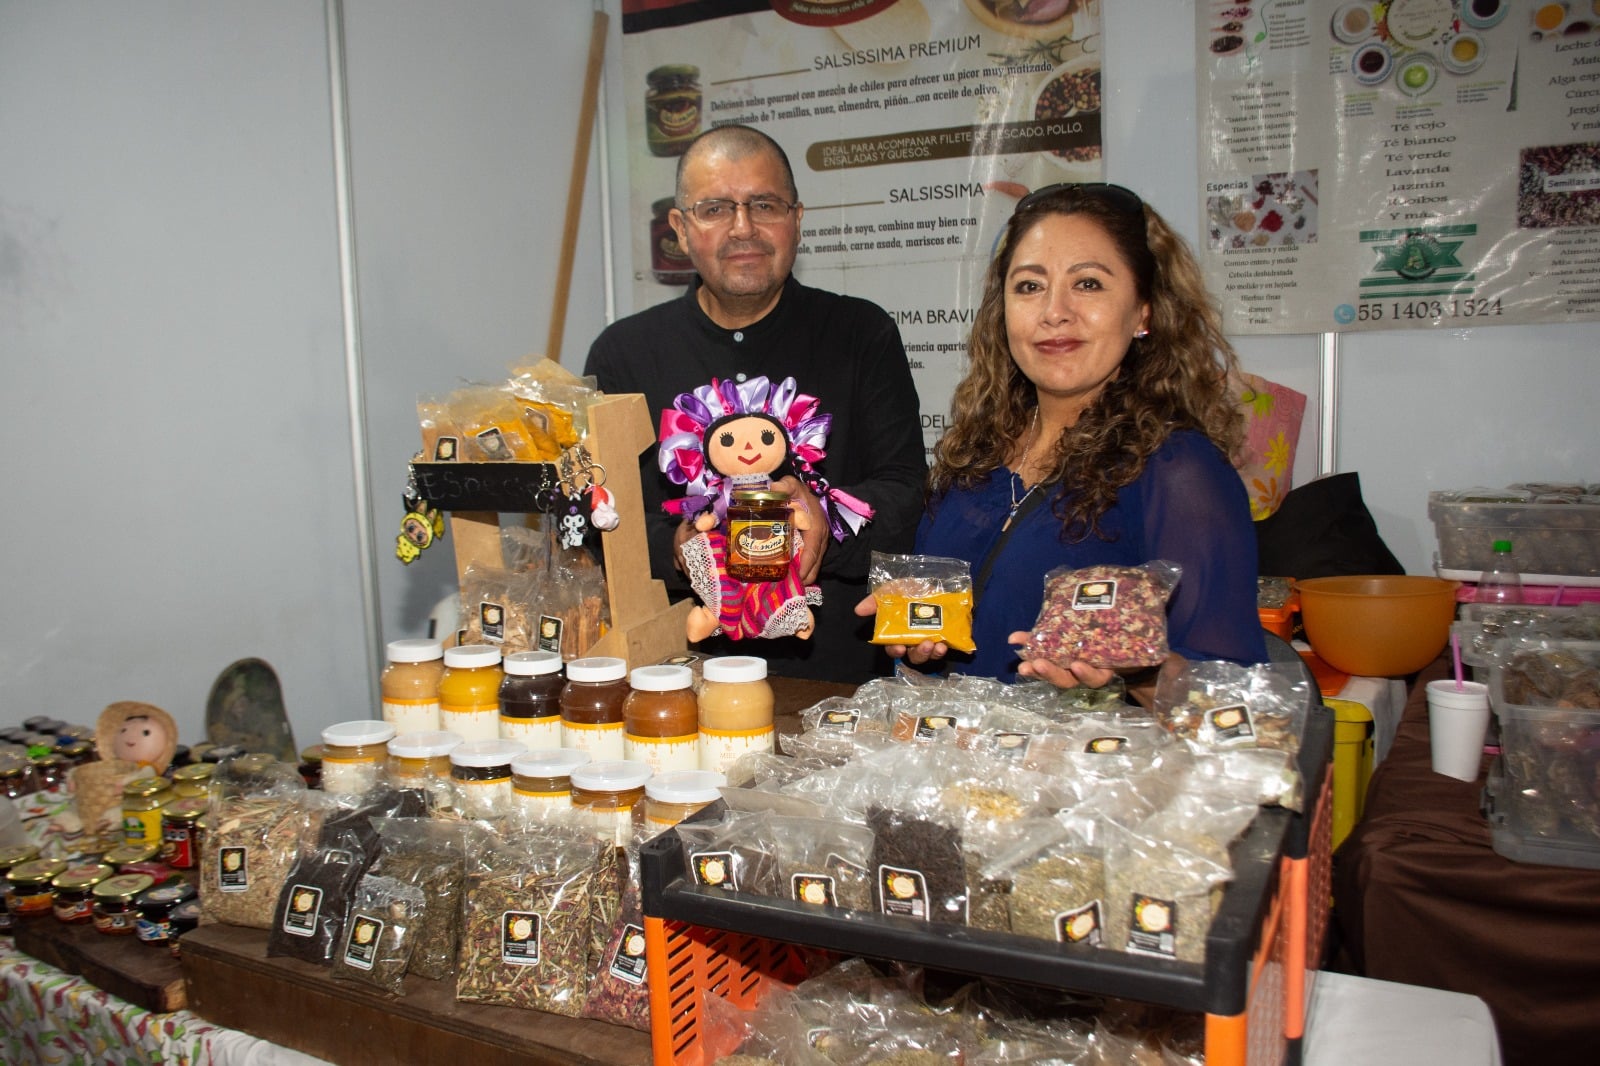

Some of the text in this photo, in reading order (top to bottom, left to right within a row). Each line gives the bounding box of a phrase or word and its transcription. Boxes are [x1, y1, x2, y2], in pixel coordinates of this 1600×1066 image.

[814, 34, 981, 70] SALSISSIMA PREMIUM
[1555, 40, 1592, 53] Leche
[768, 91, 800, 107] gourmet
[801, 91, 815, 99] con
[818, 87, 846, 98] mezcla
[848, 83, 858, 93] de
[860, 80, 885, 92] chiles
[887, 79, 907, 91] para
[910, 75, 940, 87] ofrecer
[943, 73, 954, 82] un
[958, 68, 979, 83] picor
[983, 67, 1004, 78] muy
[1008, 61, 1054, 75] matizado,
[761, 112, 769, 122] de
[771, 110, 776, 121] 7
[778, 107, 811, 120] semillas,
[814, 106, 835, 116] nuez,
[839, 100, 881, 112] almendra,
[933, 89, 959, 102] aceite
[961, 88, 972, 97] de
[1391, 121, 1446, 132] Té rojo
[823, 145, 850, 156] IDEAL
[851, 142, 874, 153] PARA
[940, 132, 972, 145] FILETE
[1381, 134, 1457, 148] Té blanco
[823, 153, 879, 168] ENSALADAS
[879, 151, 886, 160] Y
[1385, 150, 1452, 162] Té verde
[1386, 165, 1450, 177] Lavanda
[890, 183, 985, 203] SALSISSIMA
[1206, 181, 1248, 193] Especias
[1390, 212, 1400, 221] Y
[802, 217, 977, 238] con aceite de soya, combina muy bien con
[815, 242, 848, 253] menudo,
[850, 239, 874, 250] carne
[877, 238, 903, 249] asada,
[906, 234, 945, 247] mariscos
[946, 234, 962, 244] etc.
[1358, 298, 1503, 321] 55 1403 1524
